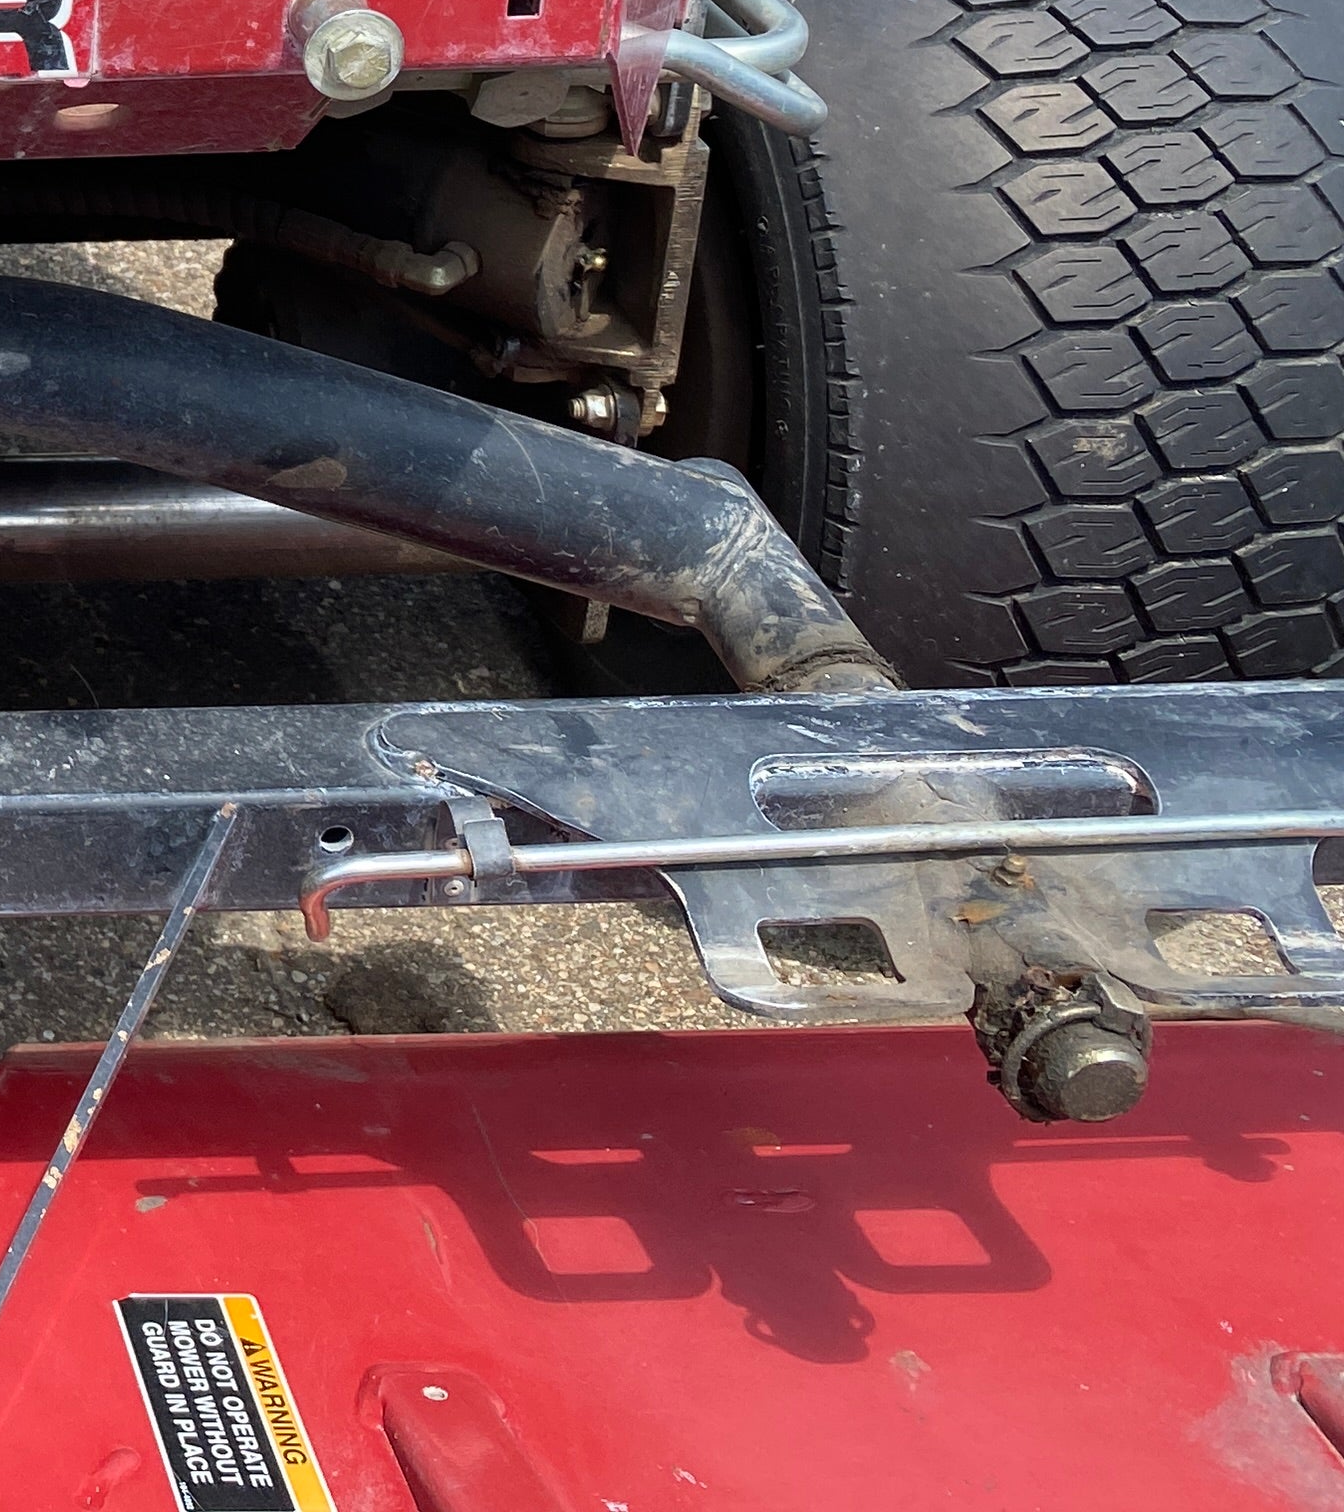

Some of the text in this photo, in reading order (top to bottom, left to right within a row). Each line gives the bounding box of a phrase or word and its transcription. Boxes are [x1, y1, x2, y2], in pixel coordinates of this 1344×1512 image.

[141, 1321, 181, 1389] GUARD
[164, 1392, 189, 1414] IN
[168, 1320, 244, 1486] MOWER WITHOUT
[194, 1318, 274, 1489] DO NOT OPERATE
[249, 1358, 308, 1466] WARNING
[171, 1418, 215, 1486] PLACE
